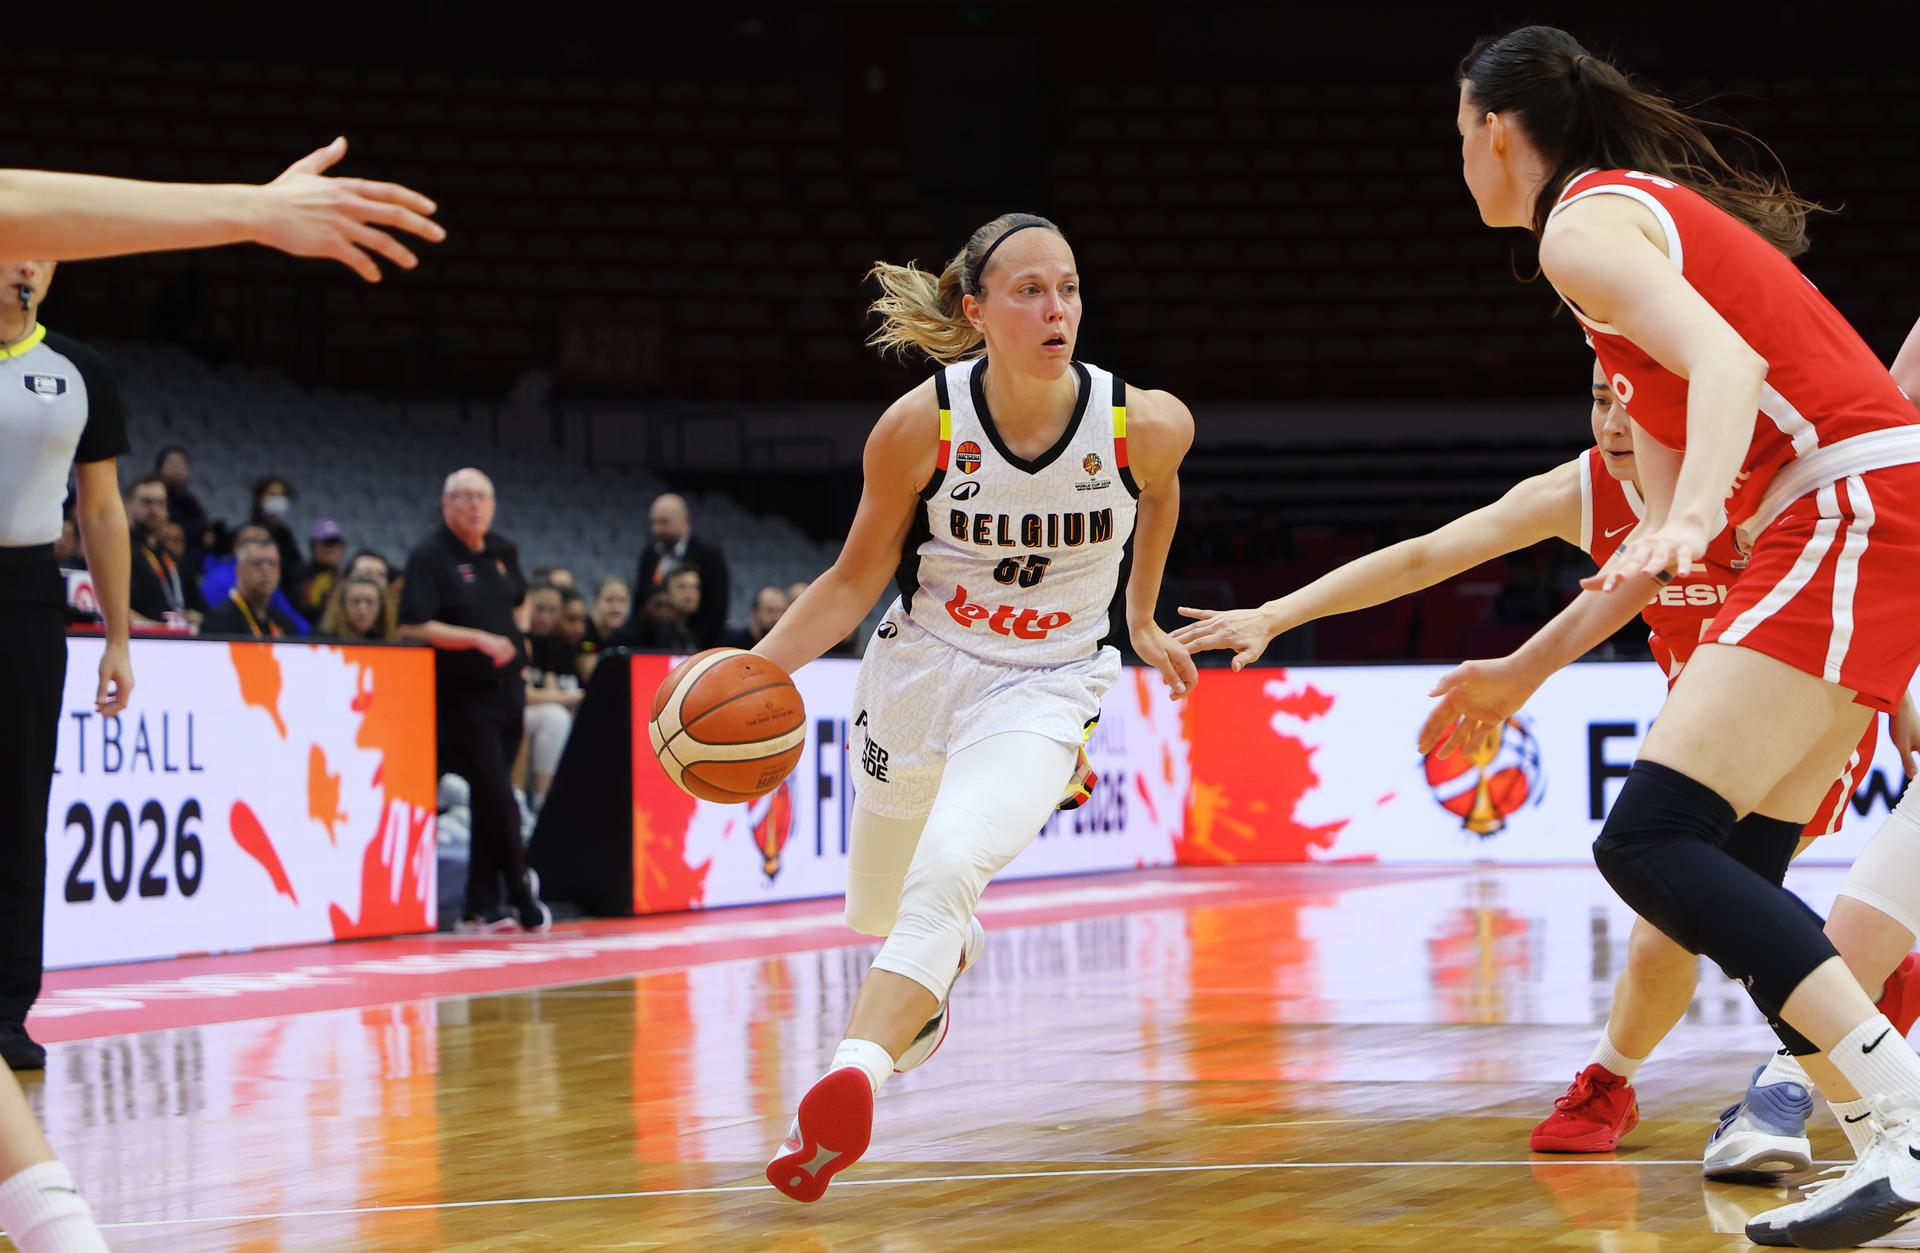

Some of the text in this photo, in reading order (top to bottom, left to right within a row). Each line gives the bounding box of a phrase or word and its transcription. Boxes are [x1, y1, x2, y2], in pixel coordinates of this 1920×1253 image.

[950, 508, 1113, 547] BELGIUM
[993, 554, 1051, 588] 65
[53, 711, 204, 775] TBALL
[64, 797, 205, 904] 2026
